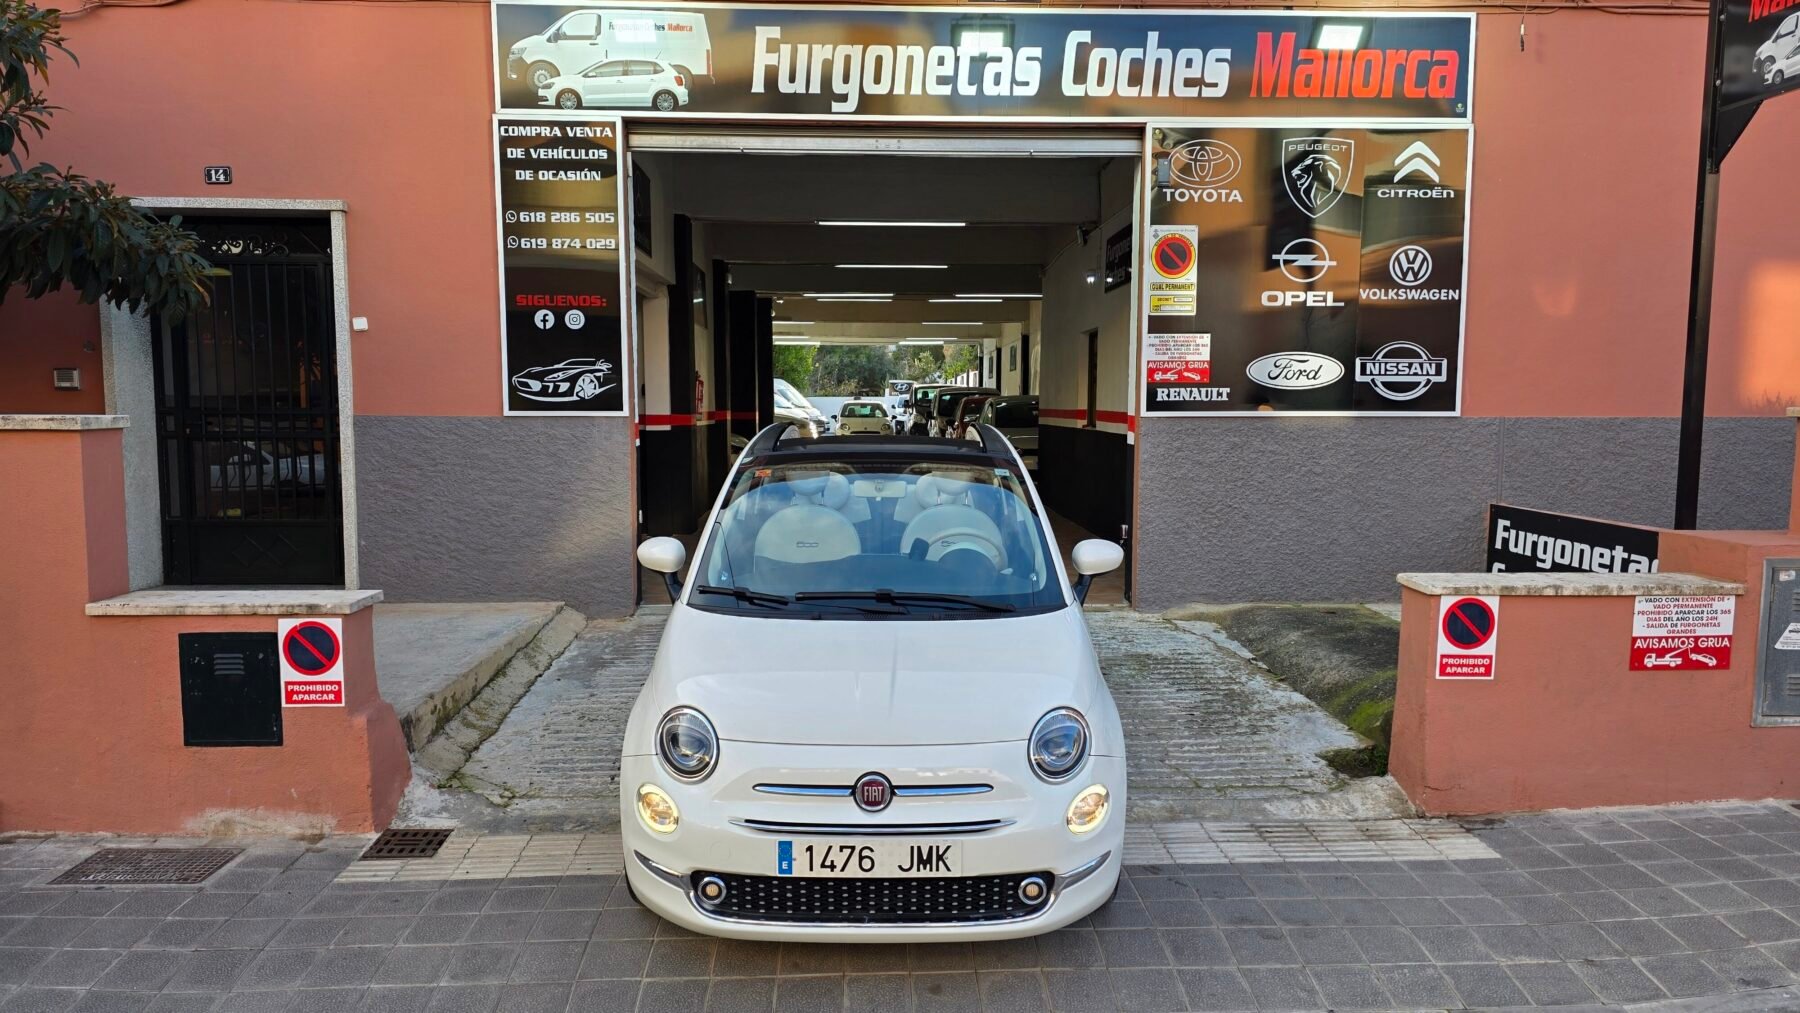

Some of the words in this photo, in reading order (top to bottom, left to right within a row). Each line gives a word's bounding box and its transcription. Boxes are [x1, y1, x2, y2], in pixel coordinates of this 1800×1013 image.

[751, 26, 1042, 112] Furgonetas
[1062, 30, 1231, 97] Coches
[1250, 32, 1459, 98] Mallorca
[500, 126, 562, 136] COMPRA
[566, 126, 613, 137] VENTA
[506, 148, 525, 158] DE
[530, 146, 608, 159] VEHÍCULOS
[1288, 143, 1348, 152] PEUGEOT
[210, 169, 225, 181] 14
[515, 170, 534, 180] DE
[538, 168, 601, 181] OCASIÓN
[1162, 188, 1243, 203] TOYOTA
[519, 212, 546, 223] 618
[551, 212, 580, 223] 286
[585, 212, 615, 223] 505
[520, 238, 547, 249] 619
[552, 238, 581, 249] 874
[586, 238, 616, 249] 029
[516, 294, 607, 307] SIGUENOS:
[1261, 290, 1345, 307] OPEL
[1359, 288, 1460, 301] VOLKSWAGEN
[1147, 361, 1186, 369] AVISAMOS
[1188, 361, 1209, 369] GRUA
[1268, 356, 1322, 382] Ford
[1365, 363, 1436, 375] NISSAN
[1156, 387, 1231, 402] RENAULT
[1634, 638, 1695, 649] AVISAMOS
[1698, 637, 1730, 648] GRUA
[287, 684, 339, 692] PROHIBIDO
[292, 693, 335, 701] APARCAR
[863, 785, 884, 802] FIAT
[782, 861, 789, 870] E
[805, 844, 876, 873] 1476
[897, 844, 952, 873] JMK
